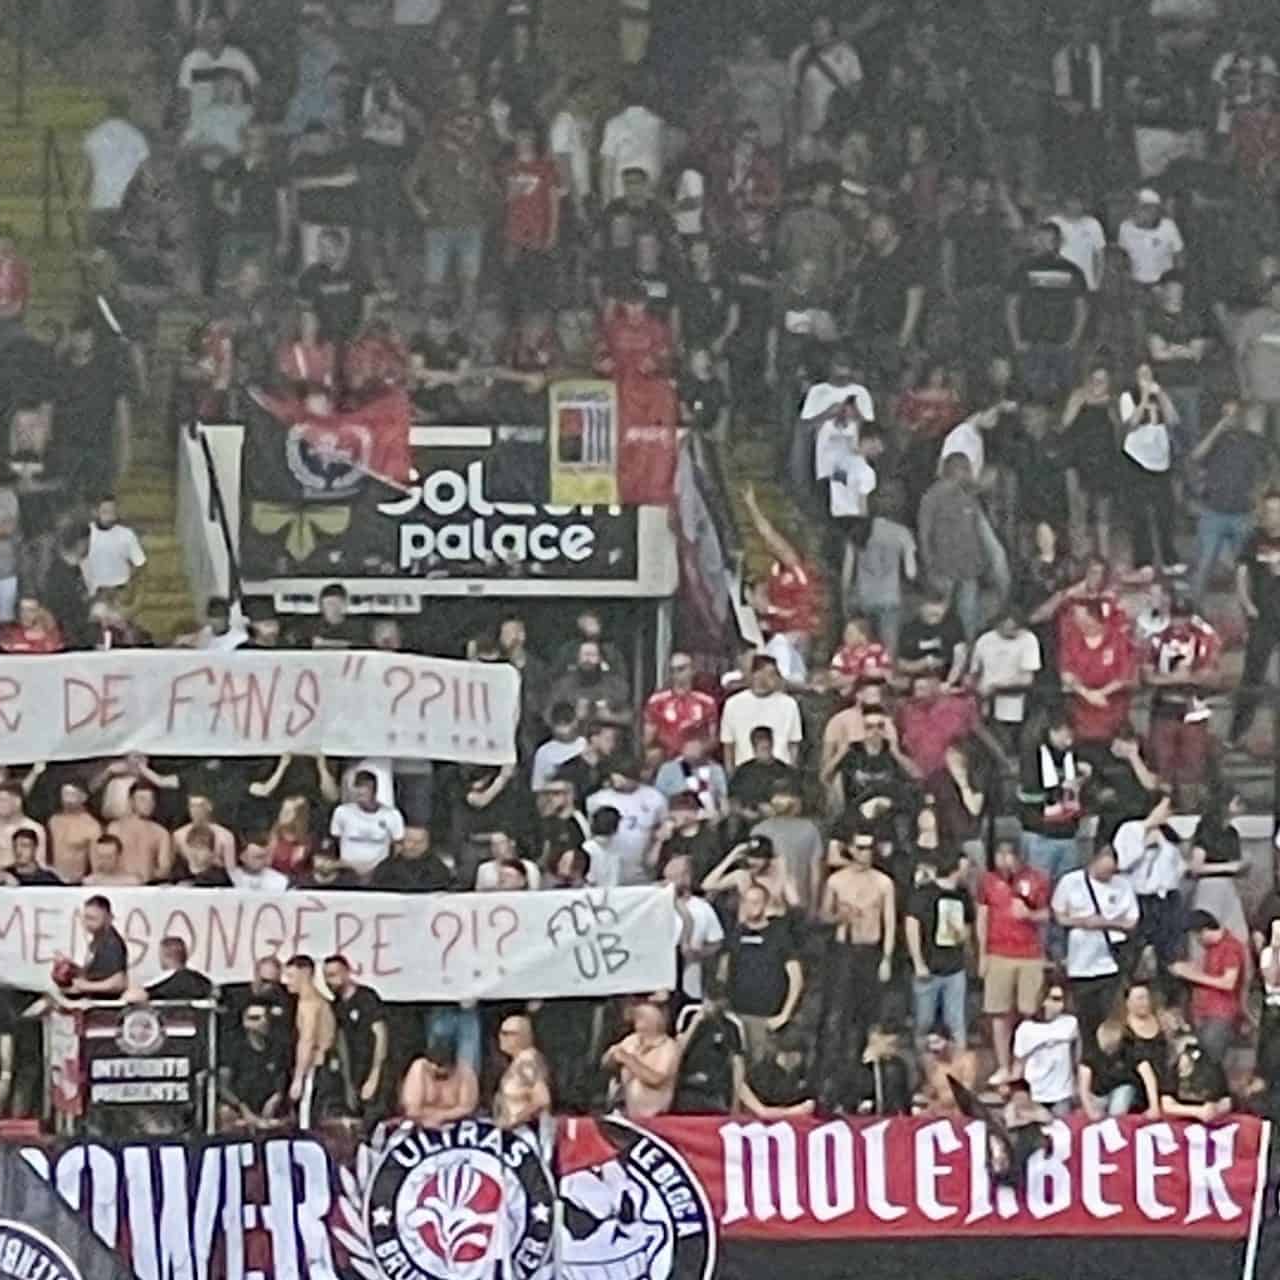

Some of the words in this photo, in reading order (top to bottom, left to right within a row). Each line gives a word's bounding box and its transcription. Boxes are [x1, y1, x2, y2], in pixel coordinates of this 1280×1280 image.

[400, 519, 595, 568] palace
[62, 675, 135, 736] DE
[430, 906, 520, 984] ?!?
[573, 932, 631, 980] UB
[391, 1120, 531, 1168] ULTRAS
[629, 1136, 664, 1171] LE
